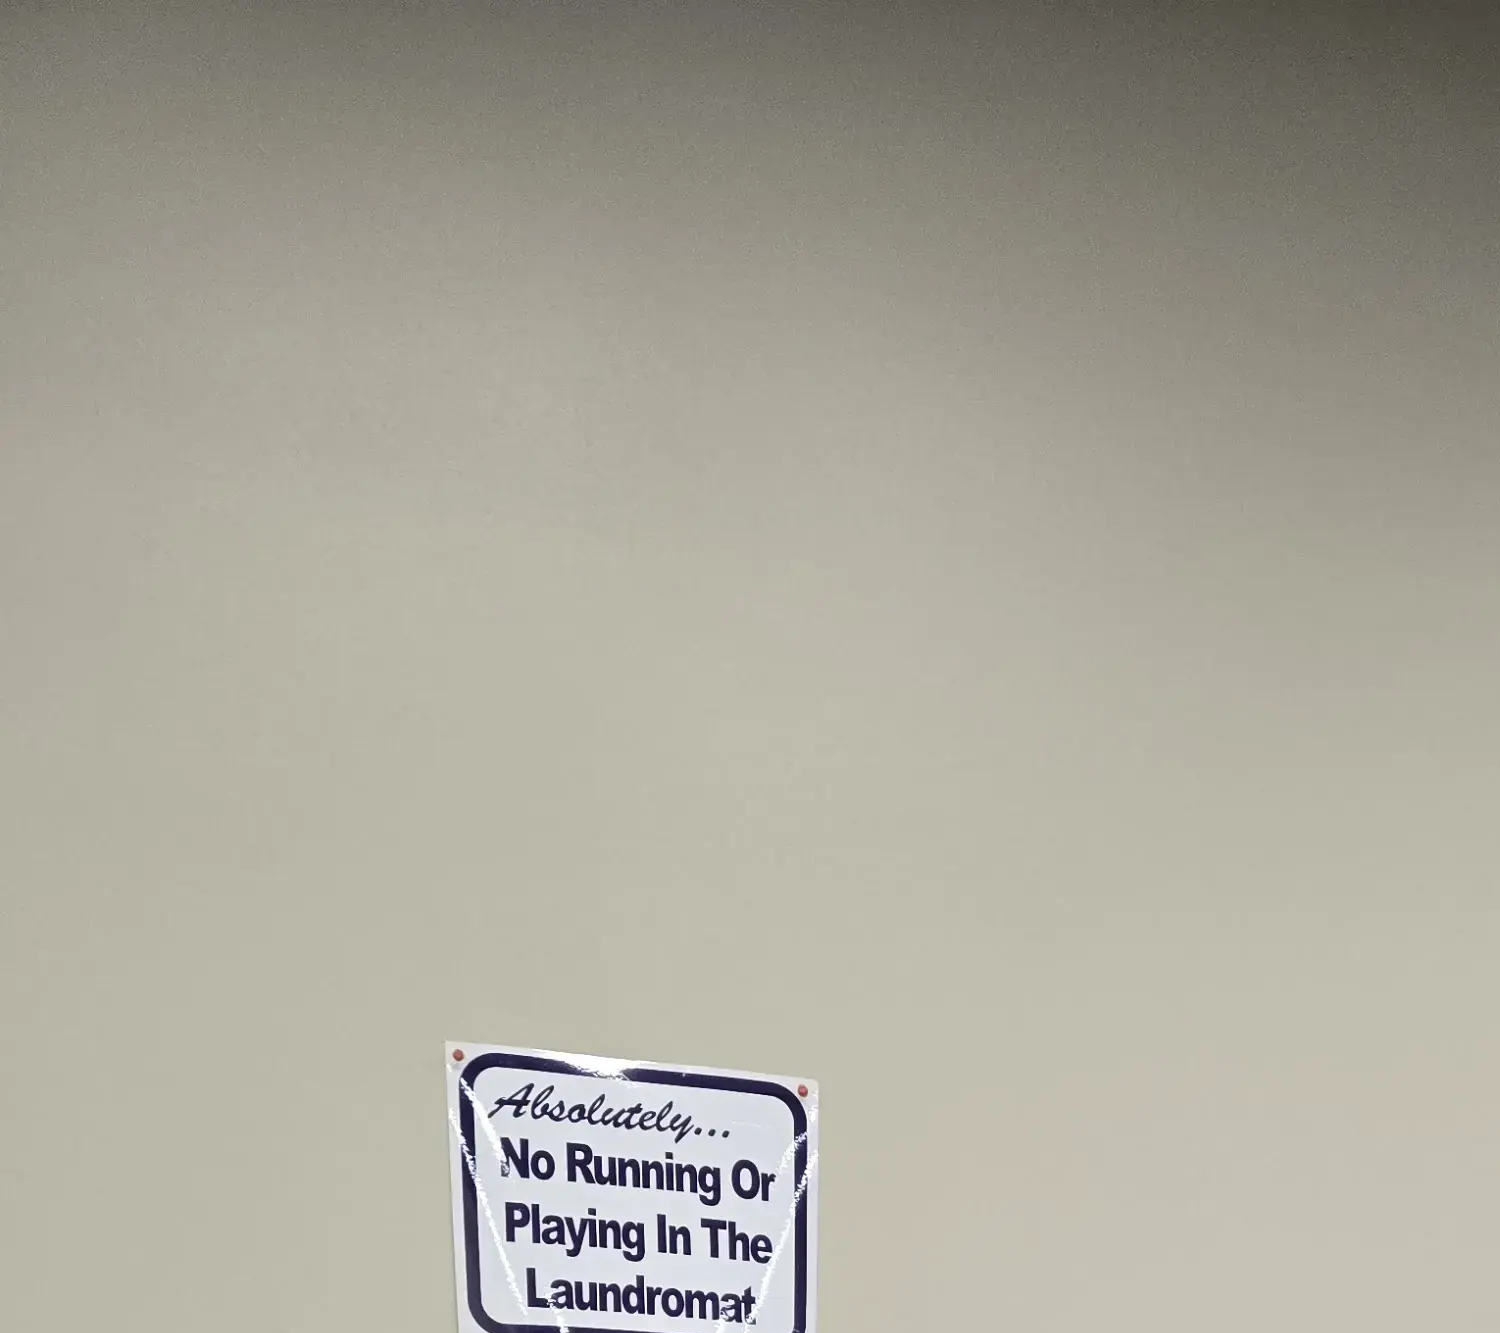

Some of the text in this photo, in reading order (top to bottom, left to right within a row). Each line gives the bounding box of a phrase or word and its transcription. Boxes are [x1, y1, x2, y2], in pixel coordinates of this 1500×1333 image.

[488, 1082, 731, 1142] Absolutely...
[499, 1137, 776, 1206] No Running Or
[504, 1201, 774, 1264] Playing In The
[525, 1268, 758, 1325] Laundromat
